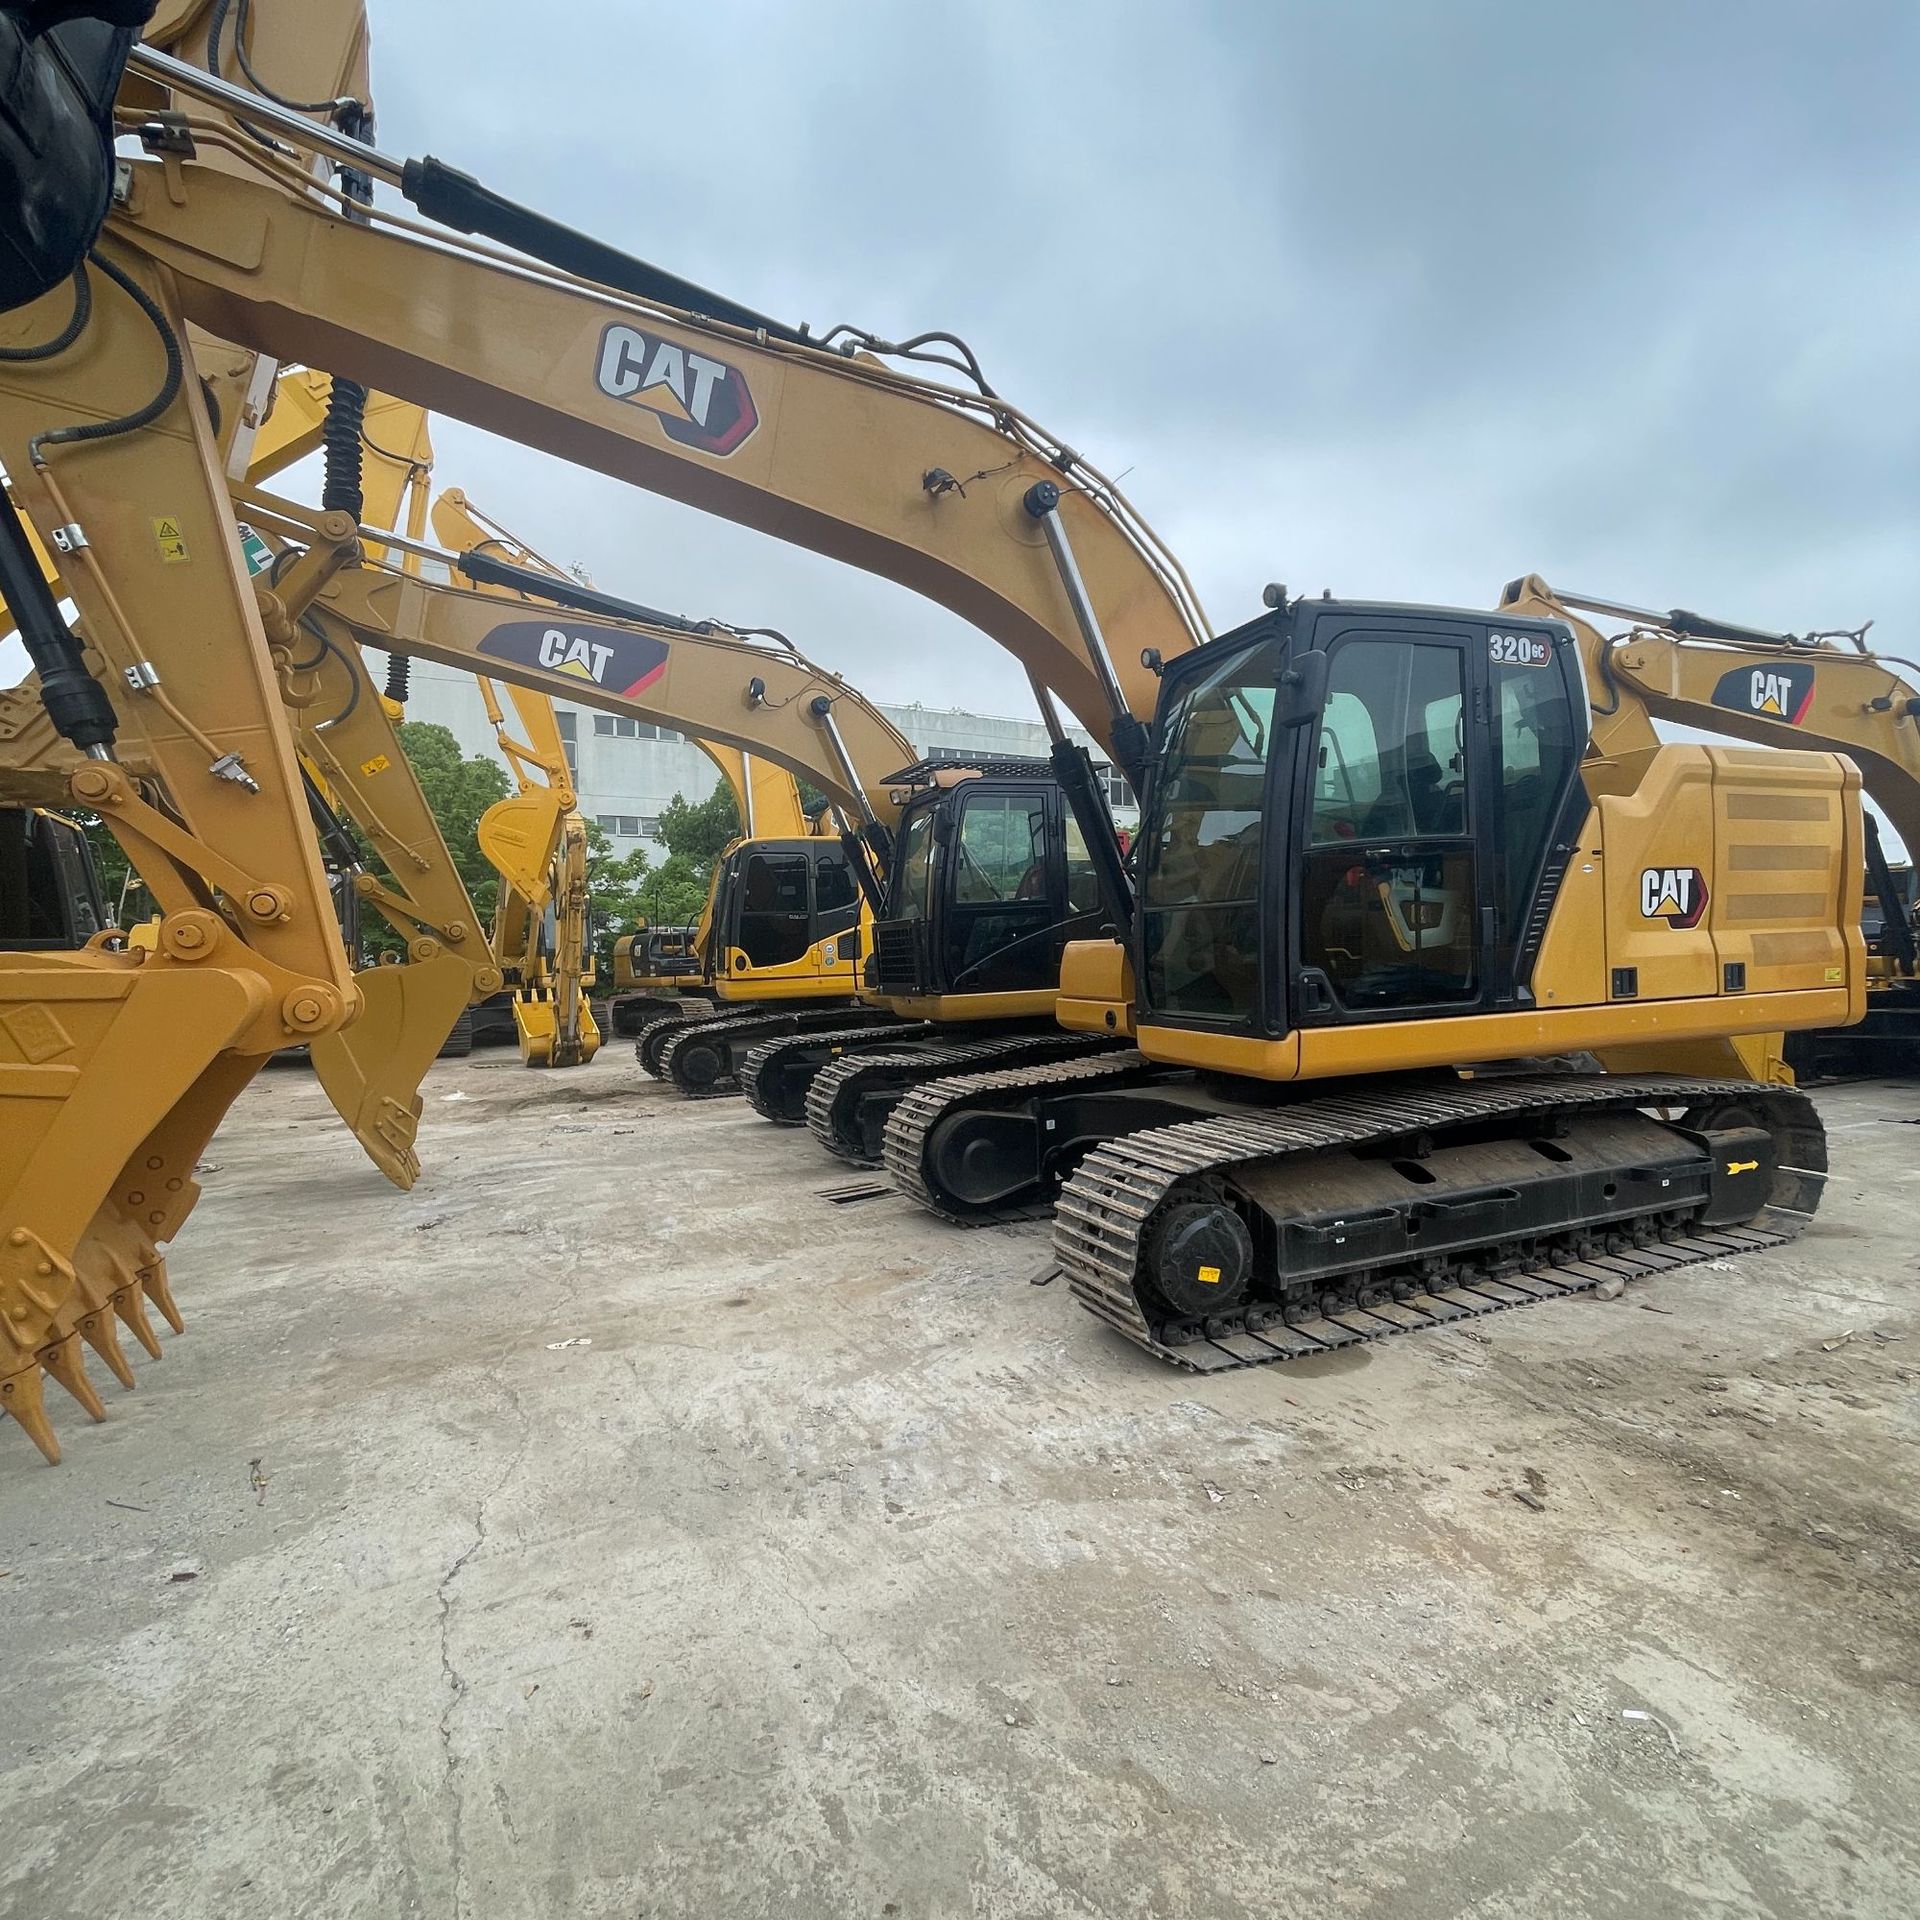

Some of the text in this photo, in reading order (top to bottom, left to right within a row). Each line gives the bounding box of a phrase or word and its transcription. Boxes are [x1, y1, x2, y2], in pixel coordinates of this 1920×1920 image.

[600, 326, 727, 428] CAT
[538, 629, 615, 684] CAT
[1750, 670, 1792, 716] CAT
[1641, 869, 1694, 917] CAT
